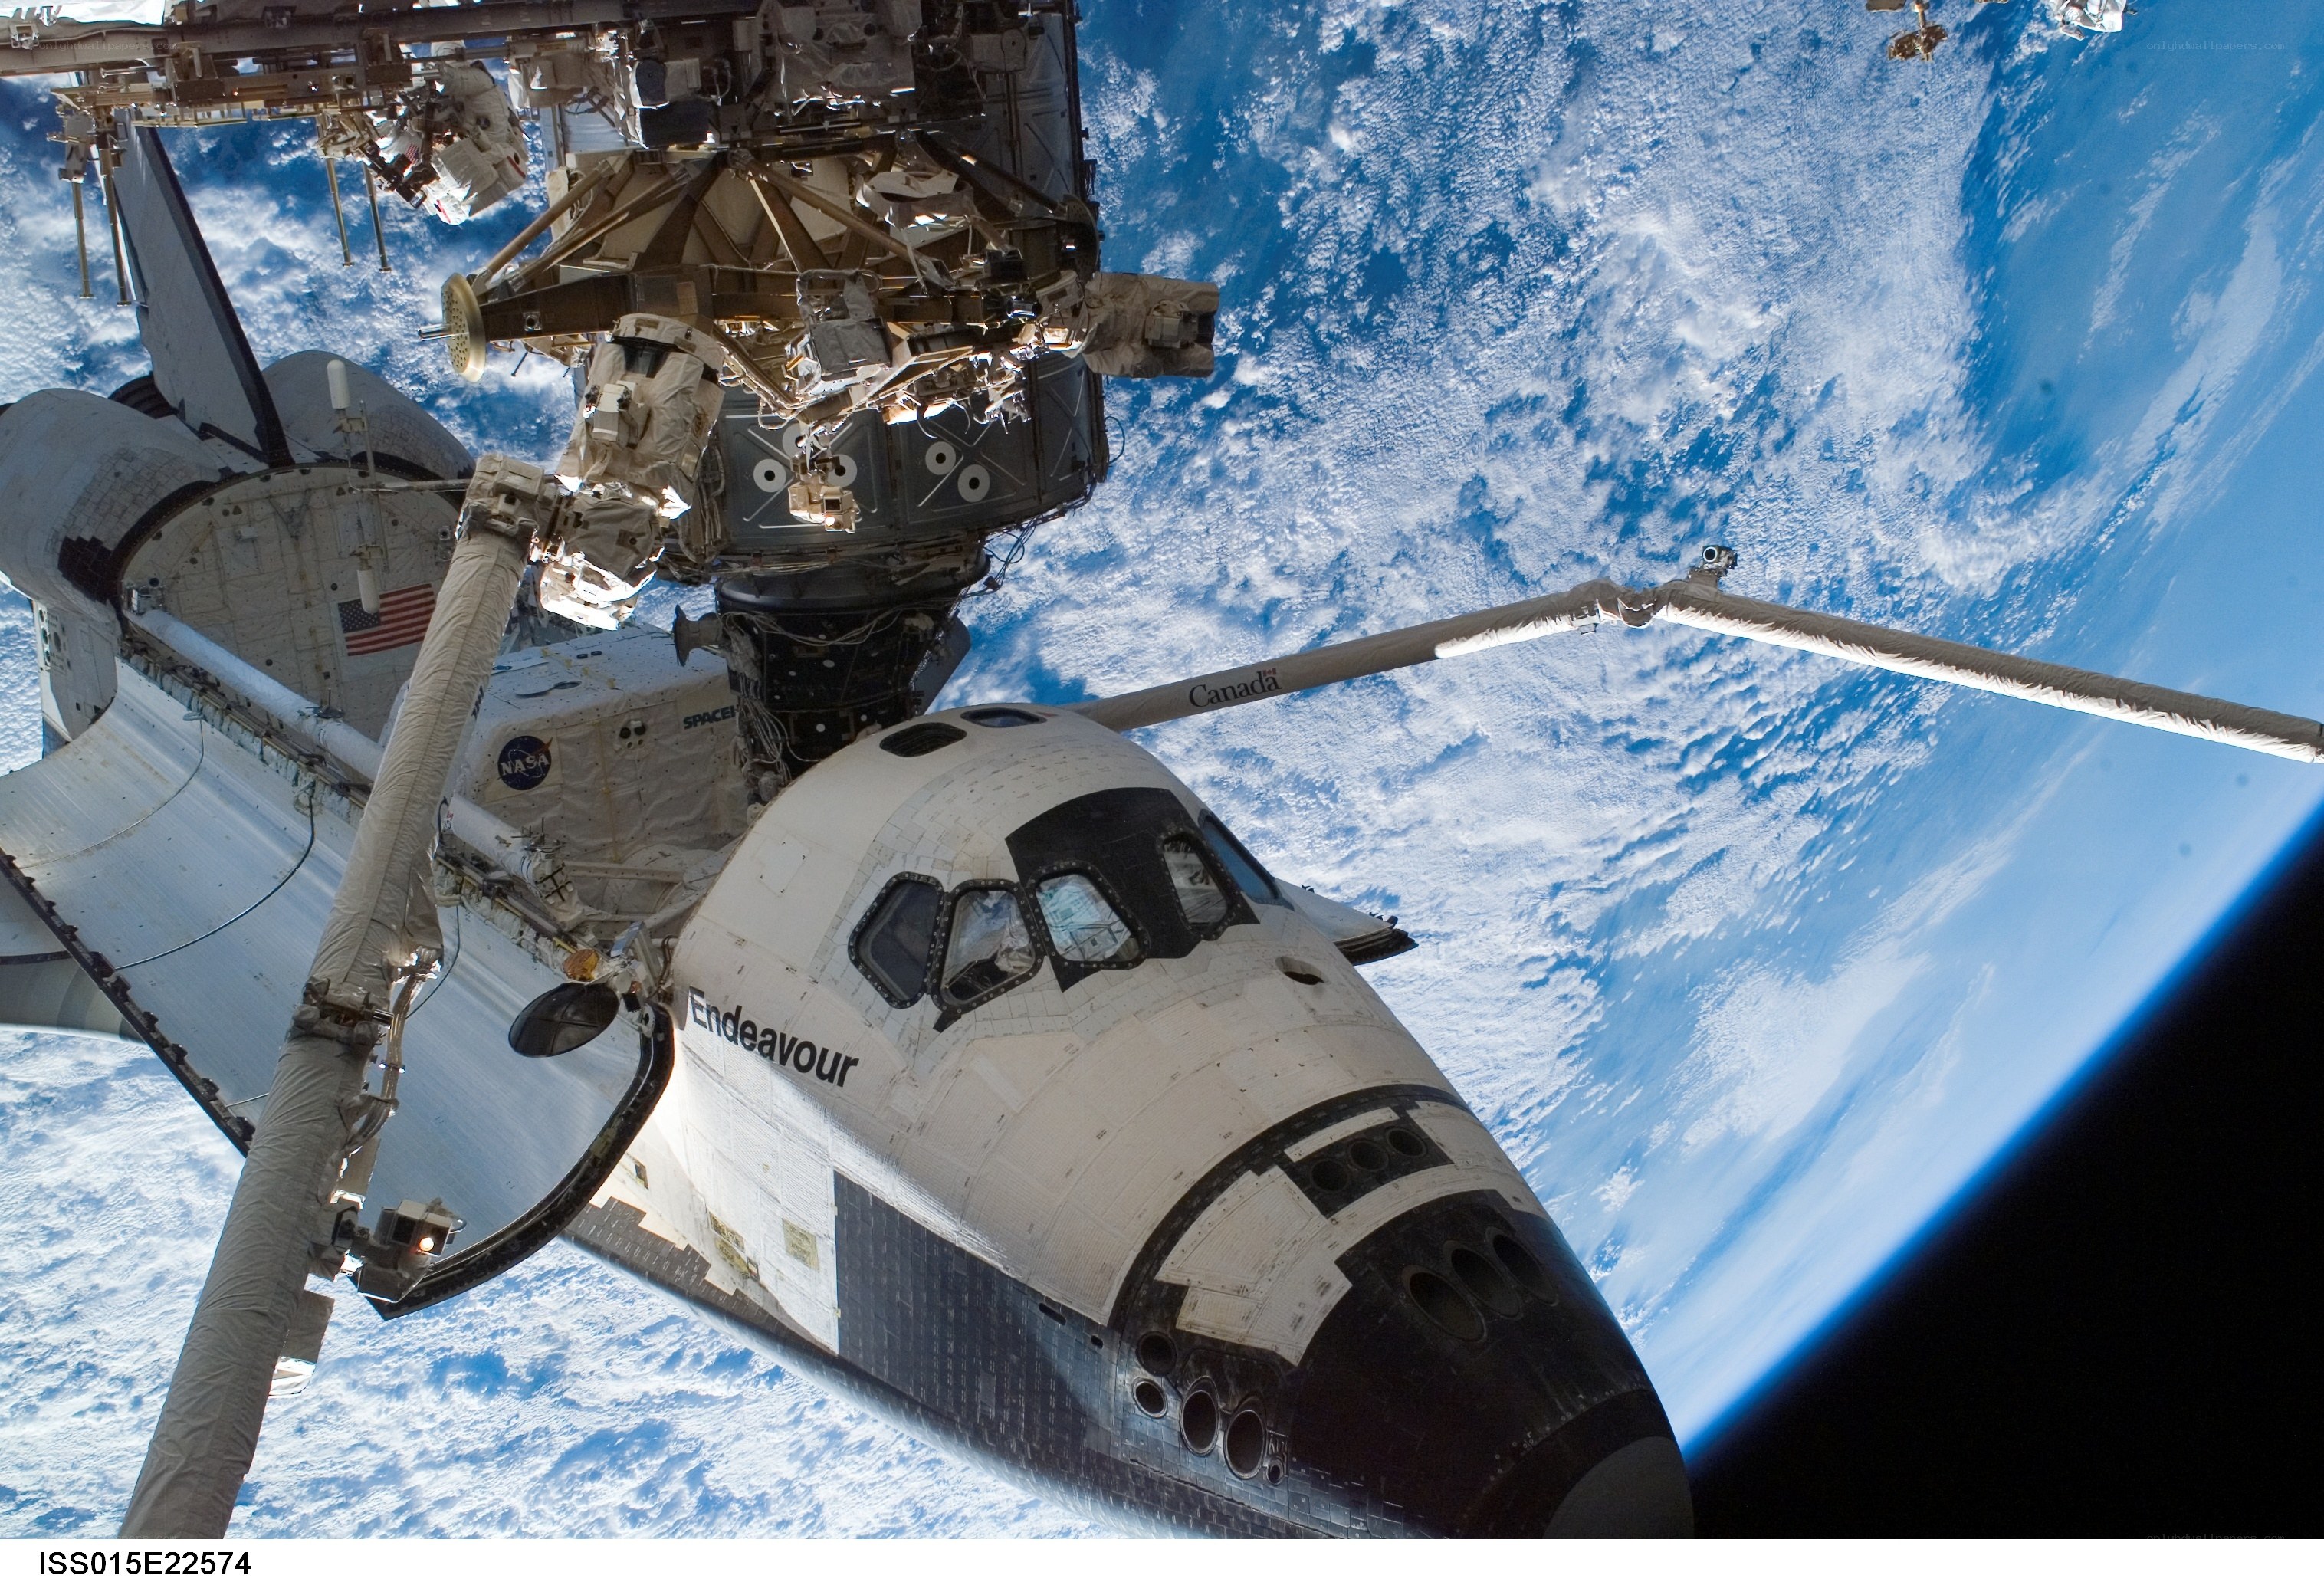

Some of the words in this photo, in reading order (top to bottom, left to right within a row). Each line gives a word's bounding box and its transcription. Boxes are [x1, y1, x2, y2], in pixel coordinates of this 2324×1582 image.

[1189, 671, 1282, 707] Canada
[500, 753, 550, 776] NASA
[689, 986, 859, 1087] Endeavour
